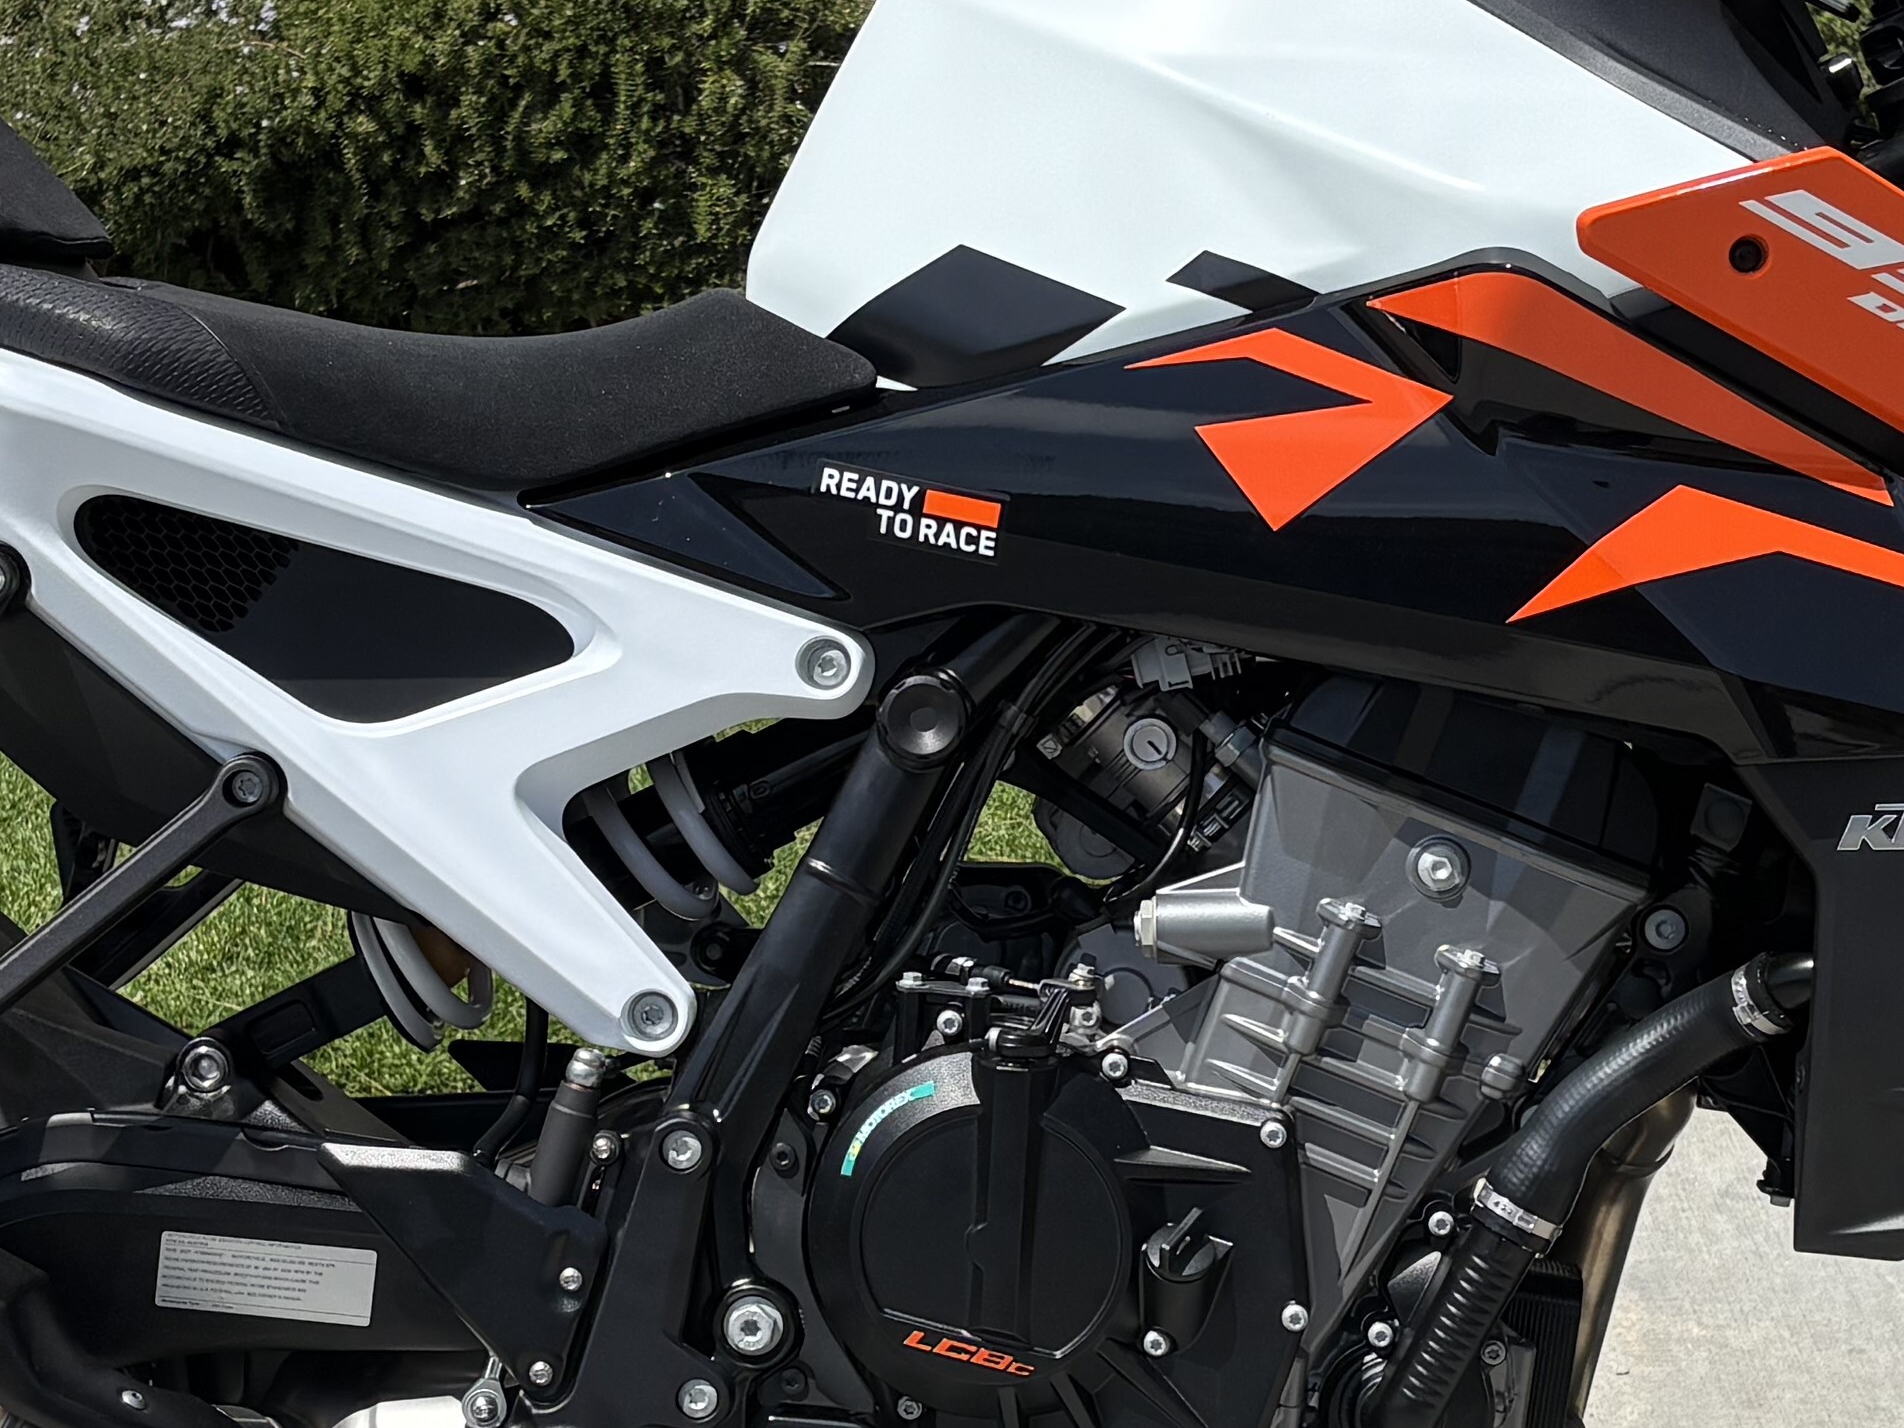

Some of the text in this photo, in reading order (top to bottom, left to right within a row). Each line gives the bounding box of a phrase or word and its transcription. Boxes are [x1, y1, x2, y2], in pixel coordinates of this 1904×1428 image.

[819, 467, 920, 512] READY
[876, 508, 997, 557] TO RACE
[855, 1087, 915, 1145] MOTOREX
